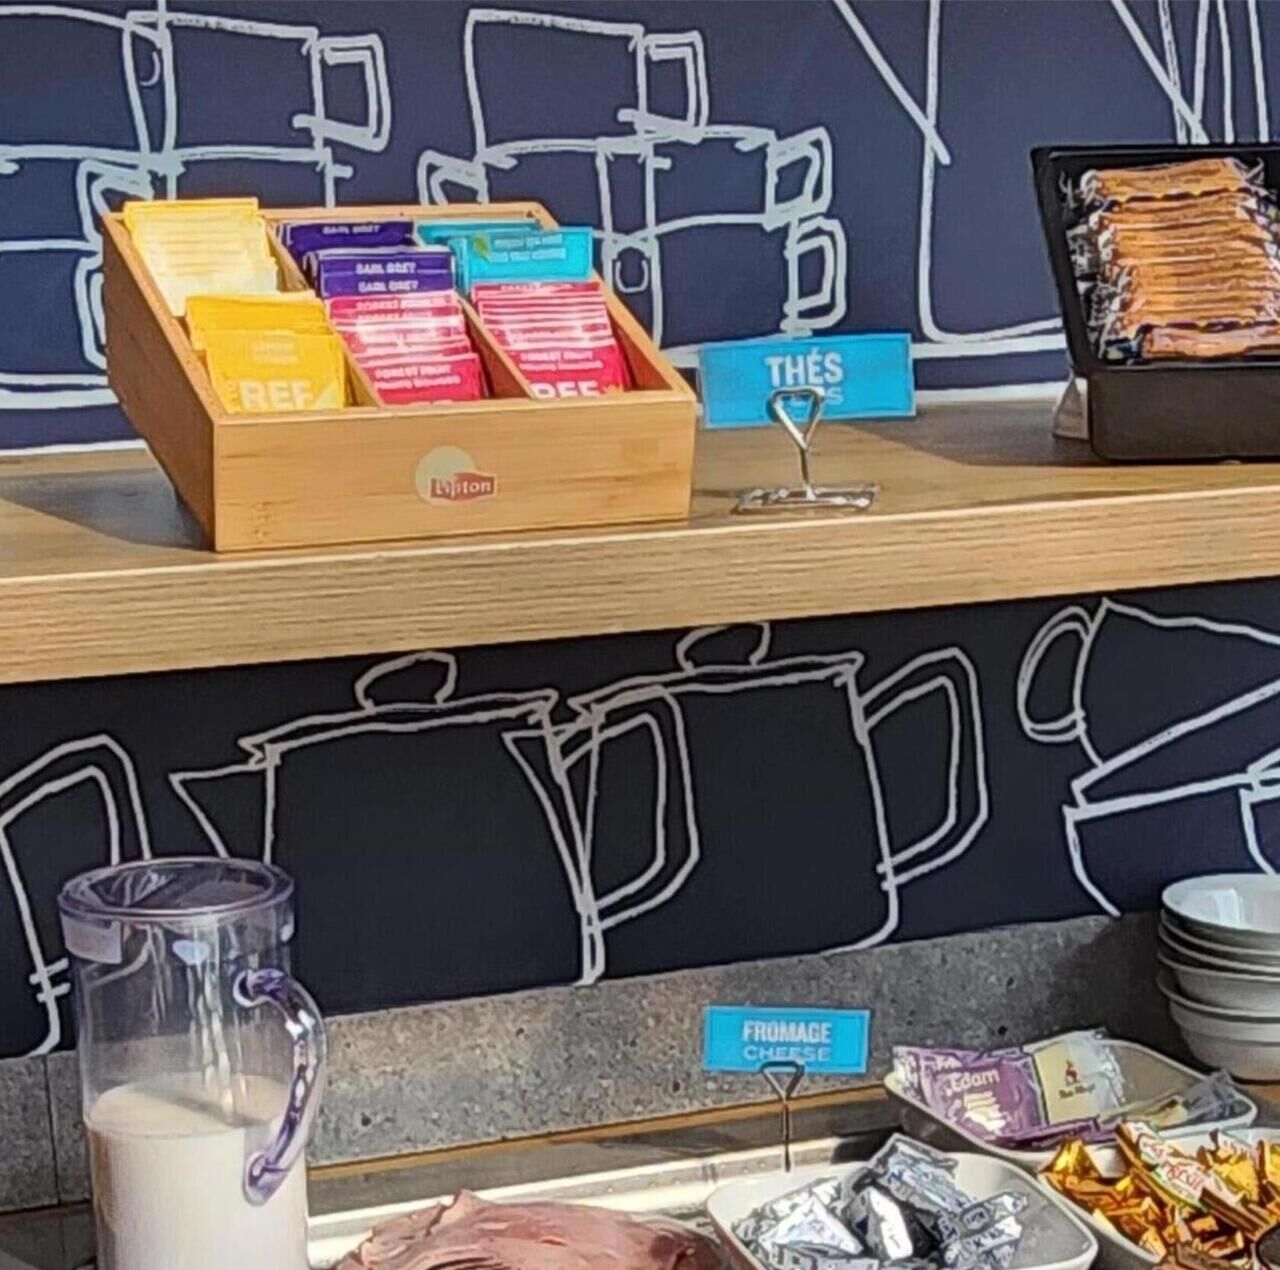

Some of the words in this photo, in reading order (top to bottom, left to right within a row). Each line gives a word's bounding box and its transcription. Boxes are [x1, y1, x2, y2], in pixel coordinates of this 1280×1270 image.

[764, 346, 844, 387] THÉS
[434, 480, 492, 499] Lipton
[742, 1020, 832, 1044] FROMAGE
[743, 1046, 832, 1062] CHEESE
[949, 1068, 1001, 1092] Edam
